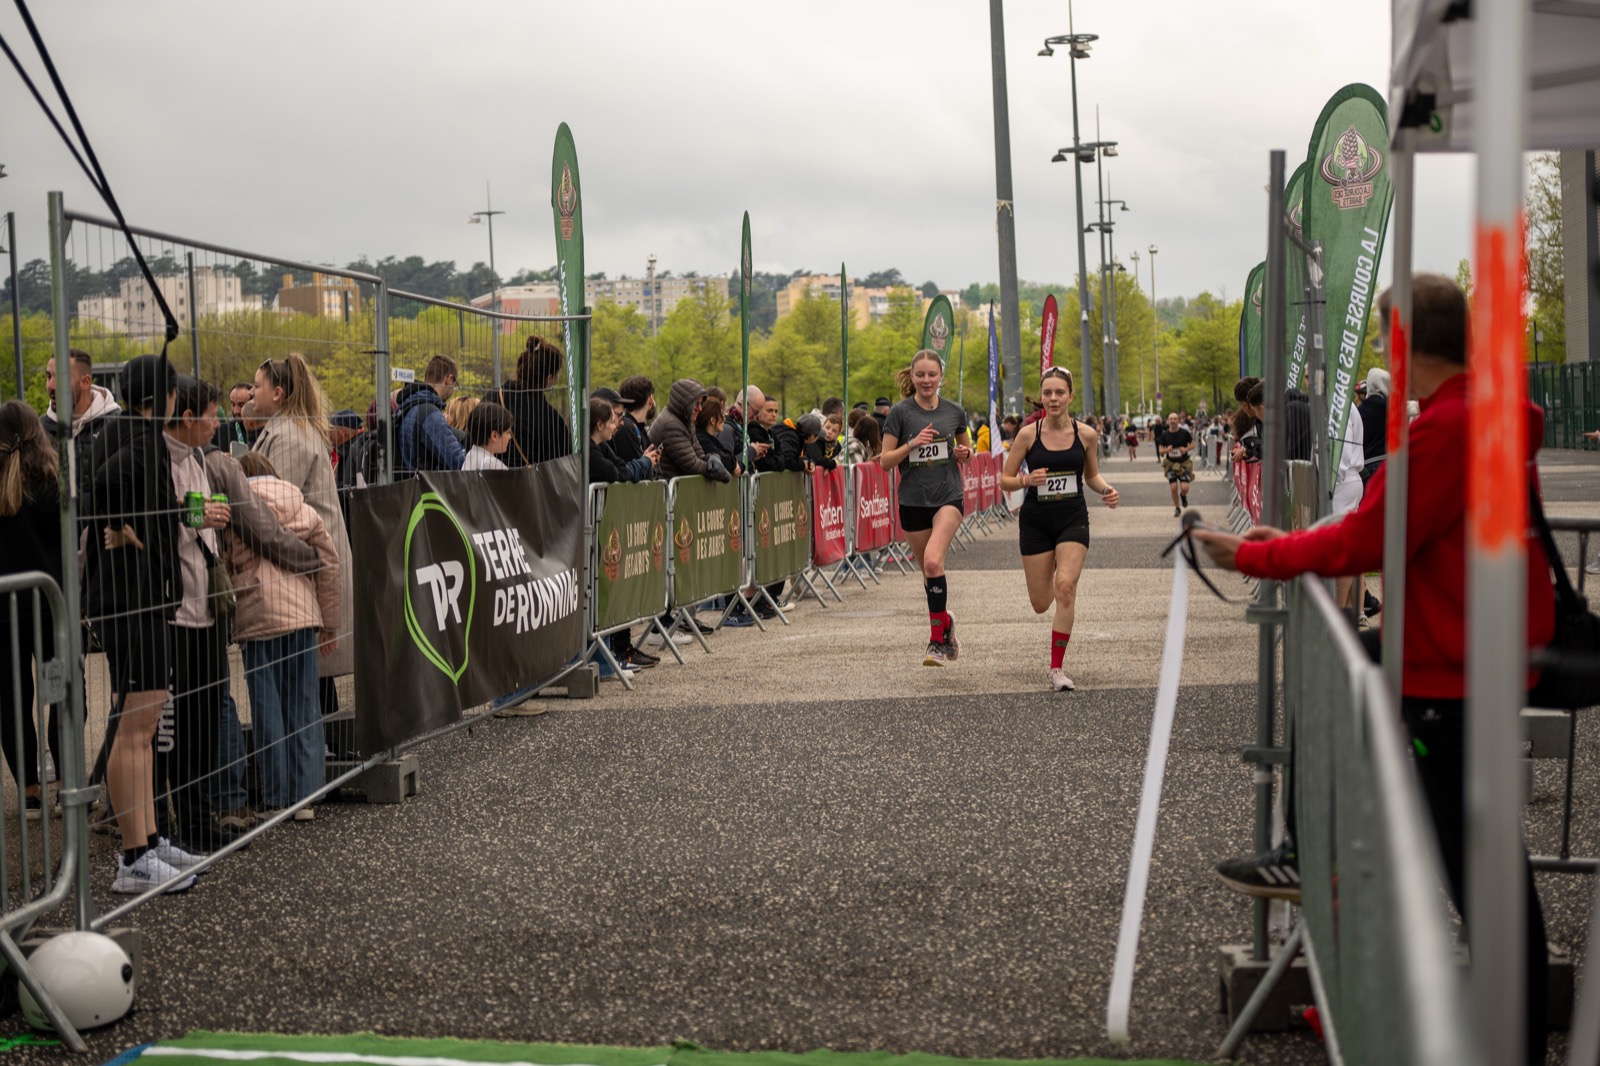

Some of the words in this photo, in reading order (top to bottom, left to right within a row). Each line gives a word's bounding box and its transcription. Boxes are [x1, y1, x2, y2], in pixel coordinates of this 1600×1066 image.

[918, 445, 939, 459] 220
[1047, 477, 1067, 492] 227
[697, 511, 706, 533] LA
[472, 528, 531, 582] TERRE
[515, 567, 578, 634] RUNNING
